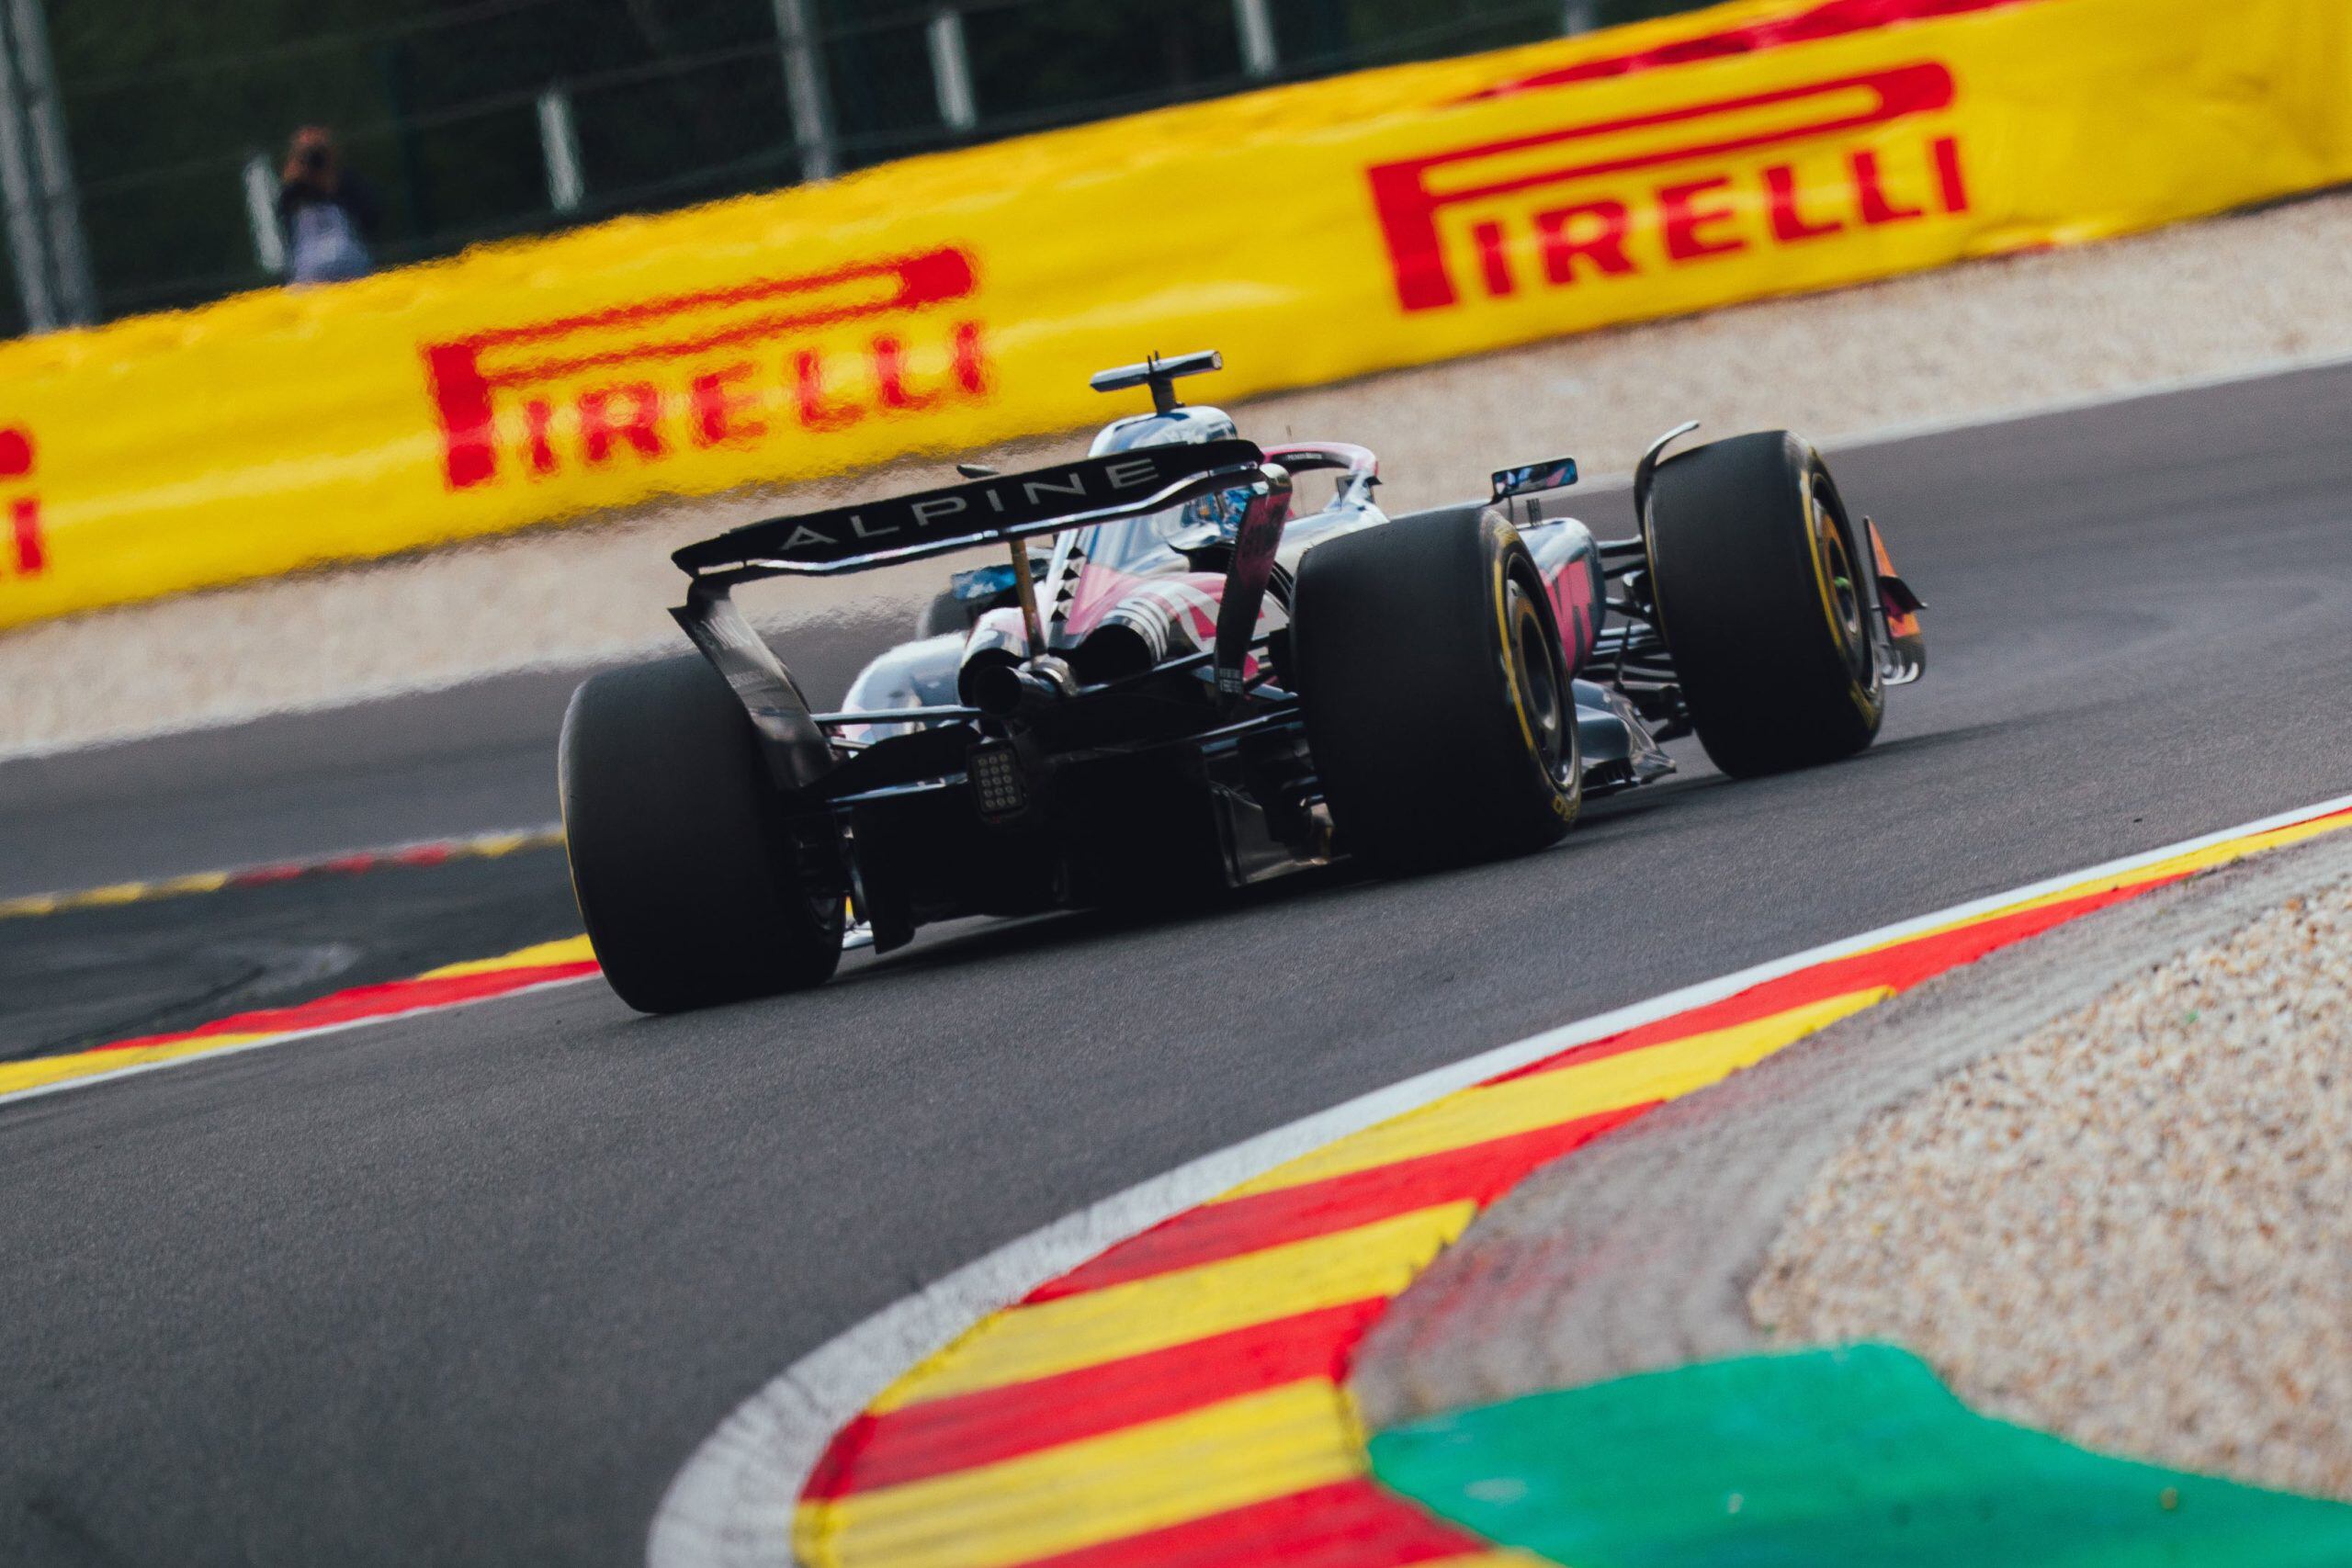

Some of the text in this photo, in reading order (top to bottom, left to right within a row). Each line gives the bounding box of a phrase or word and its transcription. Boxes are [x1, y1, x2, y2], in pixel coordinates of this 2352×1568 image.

[1365, 61, 1971, 314] PIRELLI
[425, 245, 988, 491] PIRELLI
[778, 458, 1159, 551] ALPINE
